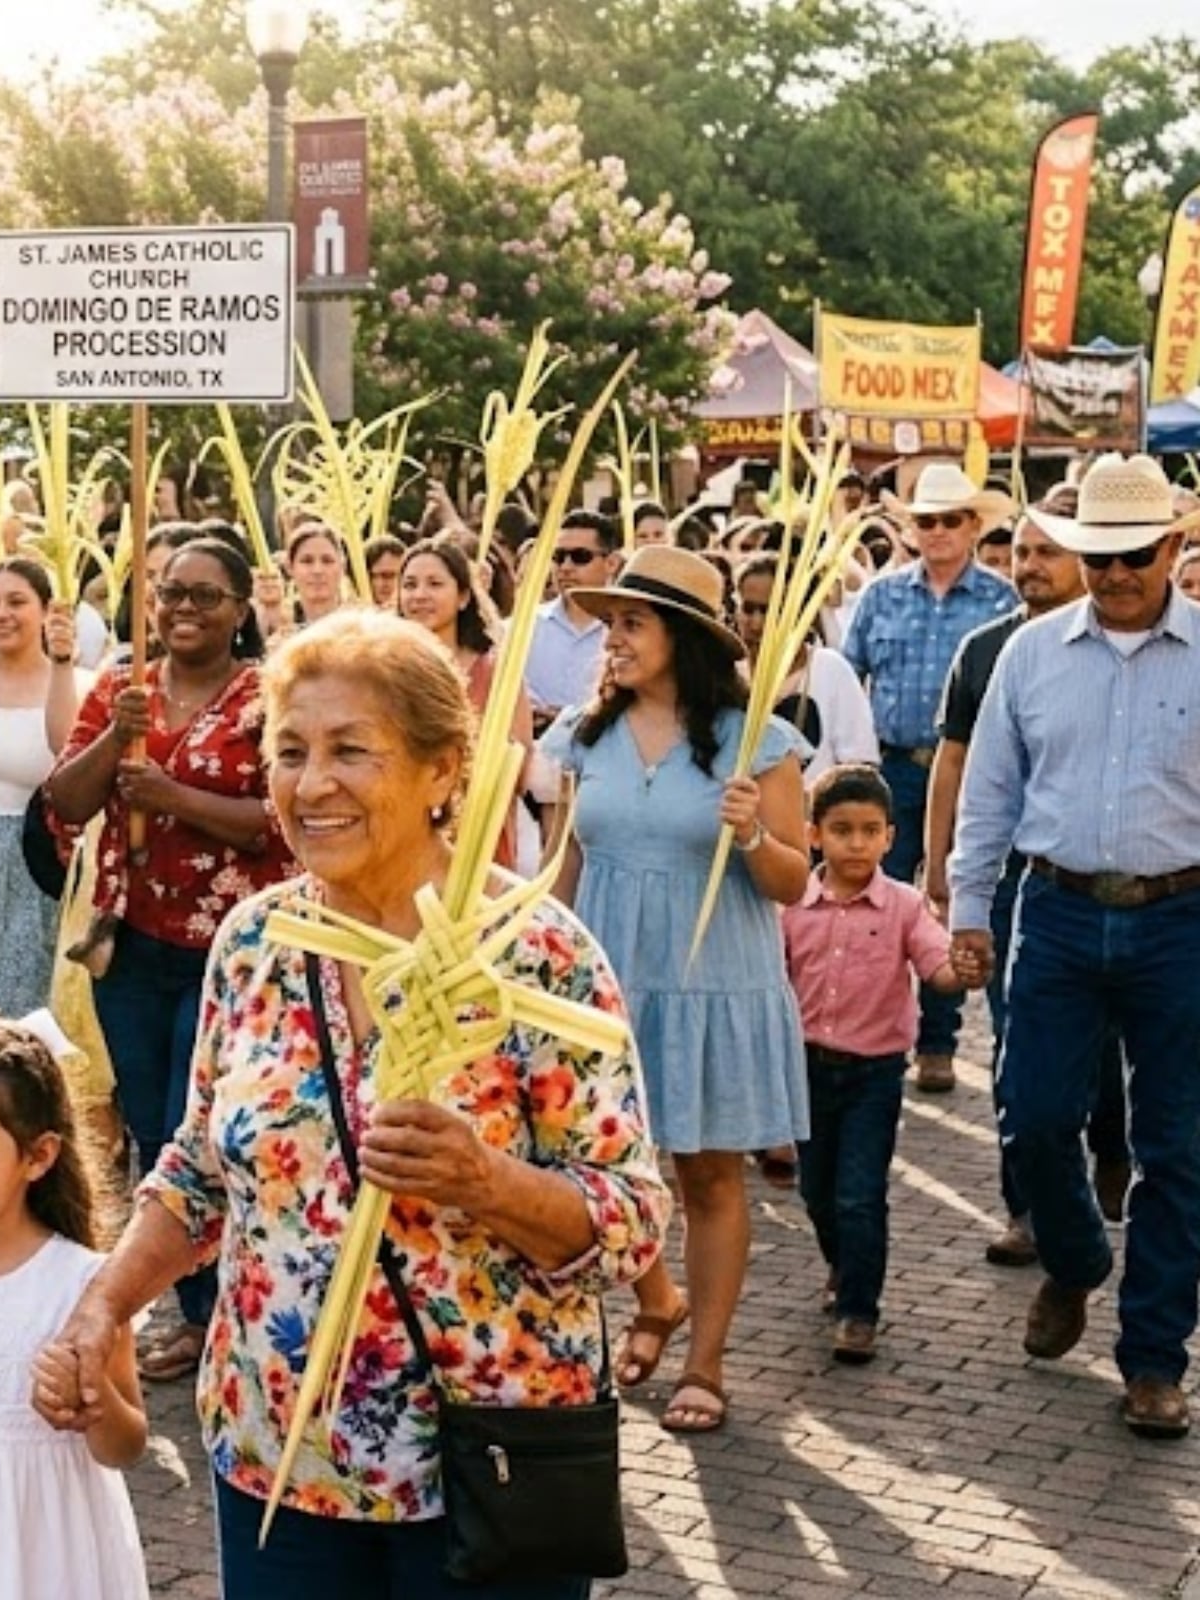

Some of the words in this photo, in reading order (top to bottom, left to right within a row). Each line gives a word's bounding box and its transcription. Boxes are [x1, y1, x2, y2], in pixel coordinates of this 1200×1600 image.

[18, 244, 51, 265] ST.
[57, 242, 137, 264] JAMES
[144, 239, 264, 262] CATHOLIC
[89, 269, 189, 289] CHURCH
[3, 297, 128, 324] DOMINGO
[136, 297, 172, 322] DE
[180, 295, 280, 322] RAMOS
[53, 330, 226, 357] PROCESSION
[56, 370, 94, 387] SAN
[100, 369, 192, 389] ANTONIO,
[198, 369, 223, 387] TX
[841, 360, 905, 399] FOOD
